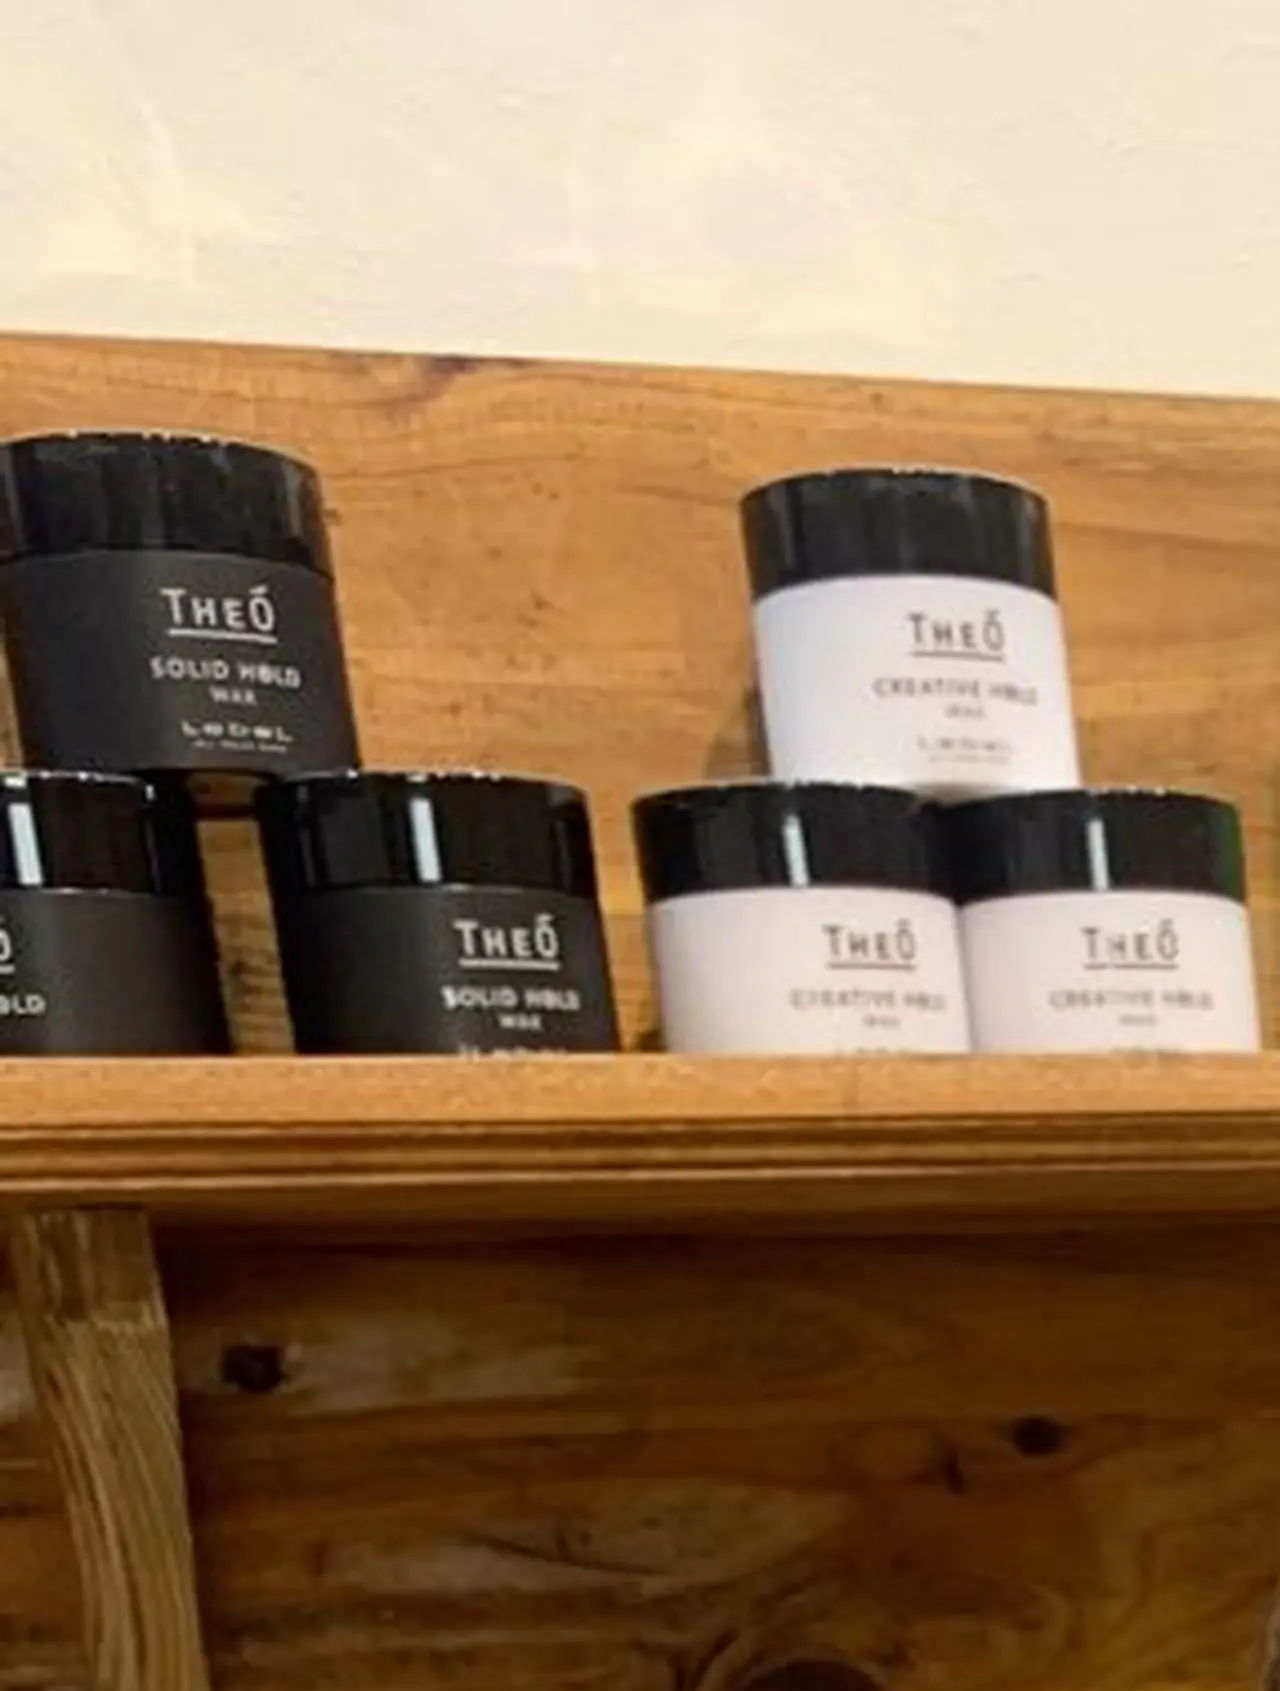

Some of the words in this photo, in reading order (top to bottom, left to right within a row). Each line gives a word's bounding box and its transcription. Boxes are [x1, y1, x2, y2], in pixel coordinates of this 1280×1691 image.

[150, 656, 229, 679] SOLID
[238, 663, 301, 688] HOLD
[442, 985, 519, 1010] SOLID
